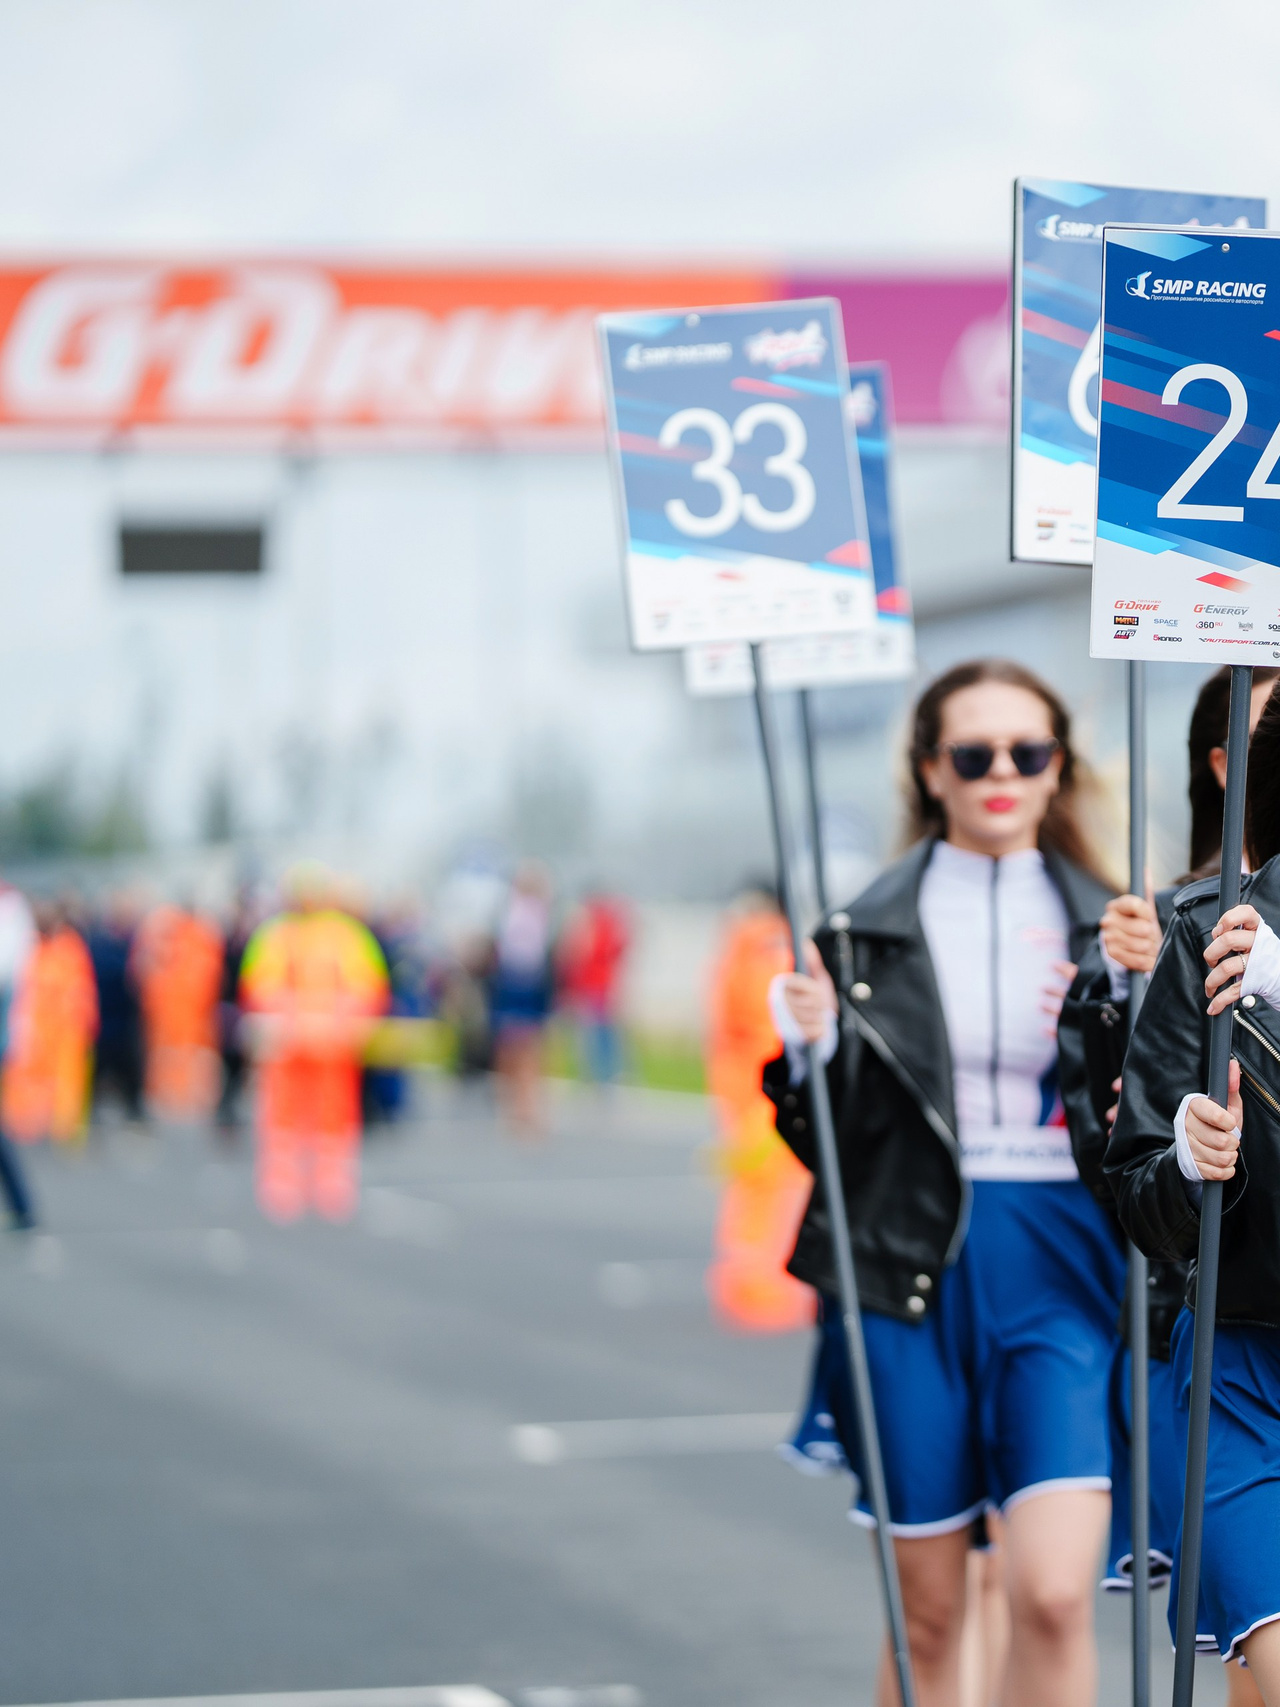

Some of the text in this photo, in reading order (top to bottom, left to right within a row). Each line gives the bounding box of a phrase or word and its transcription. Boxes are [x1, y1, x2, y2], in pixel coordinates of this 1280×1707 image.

[1151, 279, 1267, 298] SMP RACING
[1150, 294, 1180, 302] Программа
[658, 402, 817, 538] 33
[1198, 621, 1215, 629] 360
